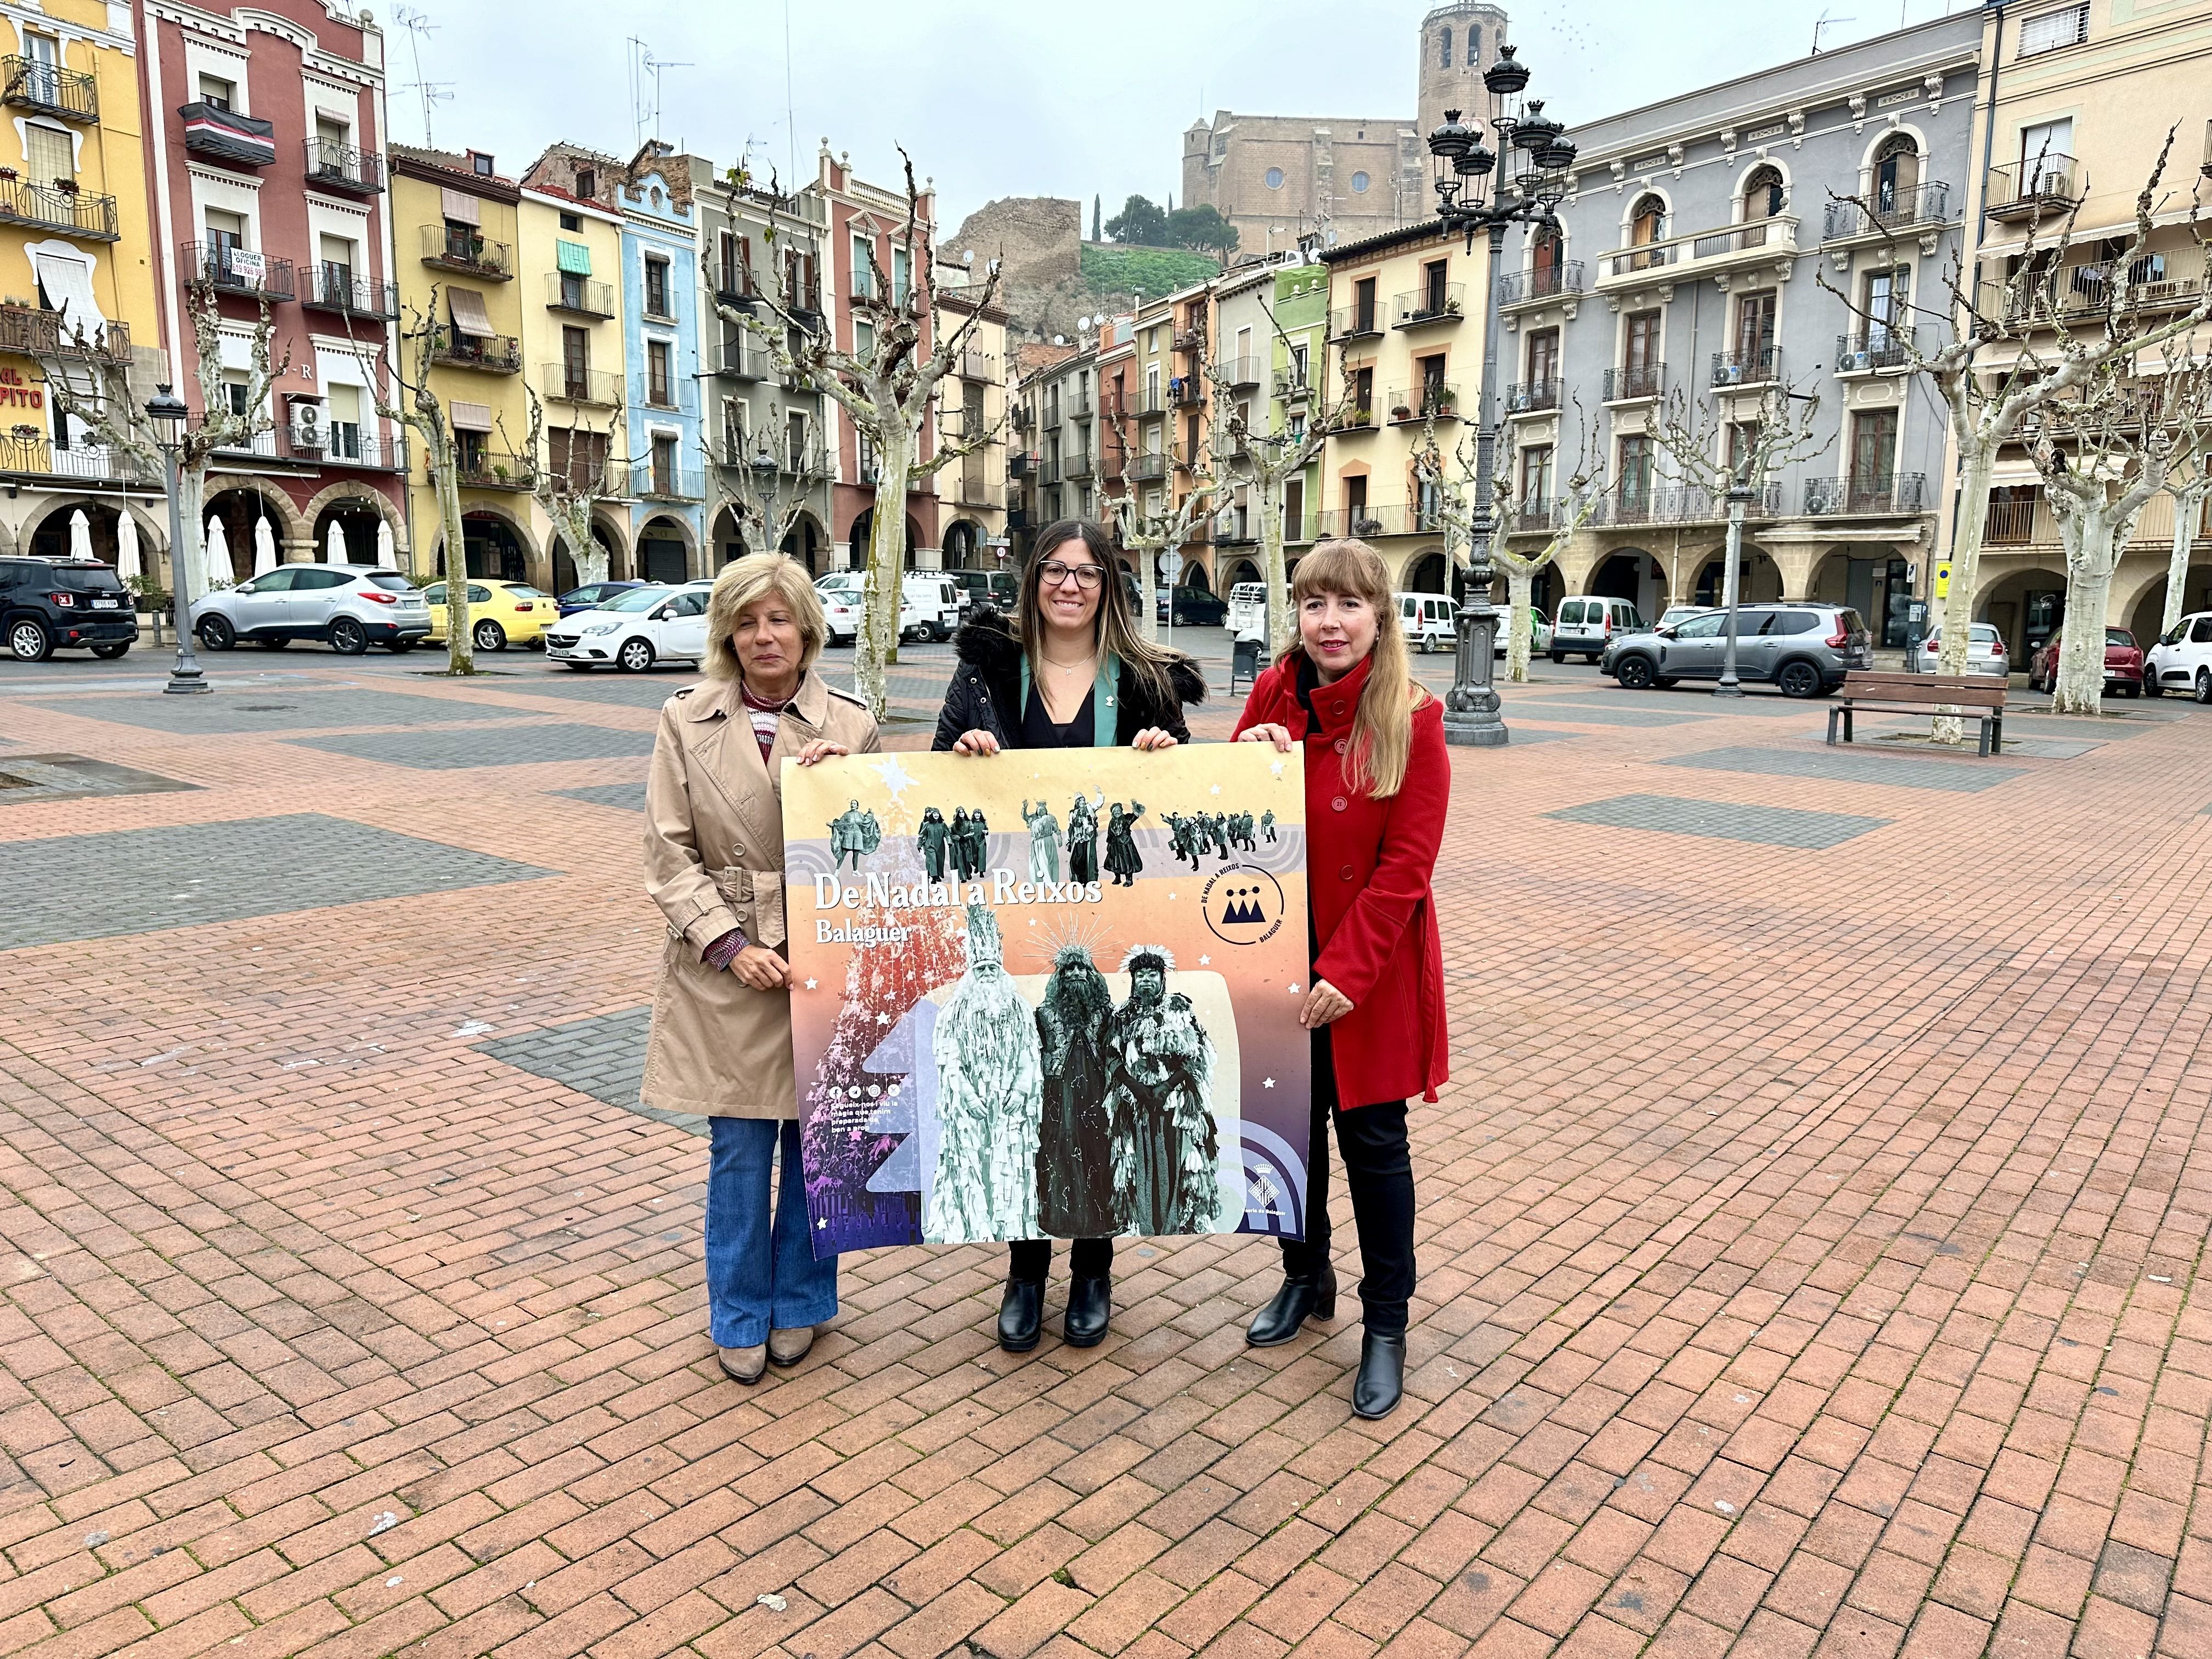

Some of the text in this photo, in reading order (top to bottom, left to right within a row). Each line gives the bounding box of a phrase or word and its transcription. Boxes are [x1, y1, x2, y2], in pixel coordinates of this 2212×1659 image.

[234, 251, 262, 261] LLOGUER
[236, 257, 260, 267] OFICINA
[232, 263, 242, 273] 619
[244, 266, 253, 275] 926
[1, 368, 22, 385] AL
[1219, 863, 1239, 876] REIXOS
[814, 868, 1102, 910] De Nadal a Reixos
[1203, 878, 1216, 895] NADAL
[1201, 895, 1208, 904] DE
[815, 918, 912, 949] Balaguer
[1259, 919, 1283, 943] BALAGUER
[831, 1118, 867, 1126] preparada
